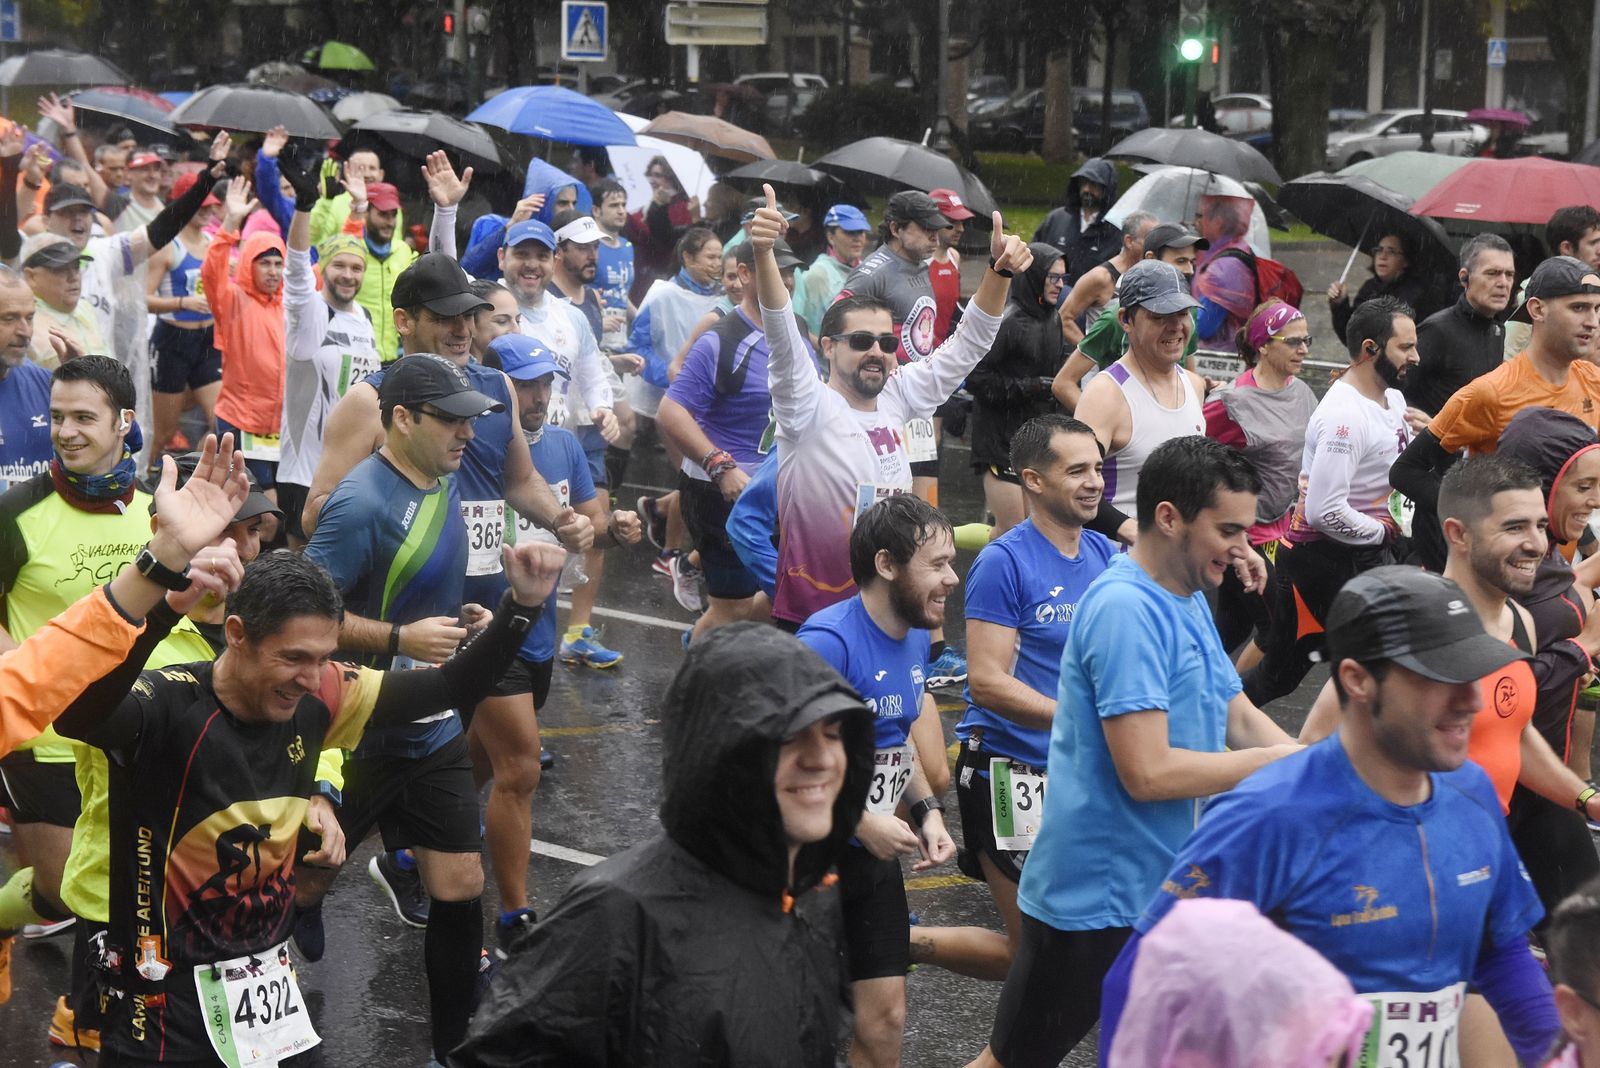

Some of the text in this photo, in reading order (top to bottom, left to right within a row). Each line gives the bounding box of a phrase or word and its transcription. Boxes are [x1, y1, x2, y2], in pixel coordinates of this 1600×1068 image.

[909, 421, 934, 439] 1400
[402, 501, 418, 530] Joma
[88, 543, 145, 558] VALDARACE
[466, 522, 503, 550] 365
[879, 694, 903, 707] ORO
[999, 788, 1007, 818] CAJÓN
[1016, 781, 1045, 812] 31
[136, 825, 153, 922] ACEITUNO
[235, 976, 299, 1029] 4322
[213, 1005, 227, 1045] CAJÓN
